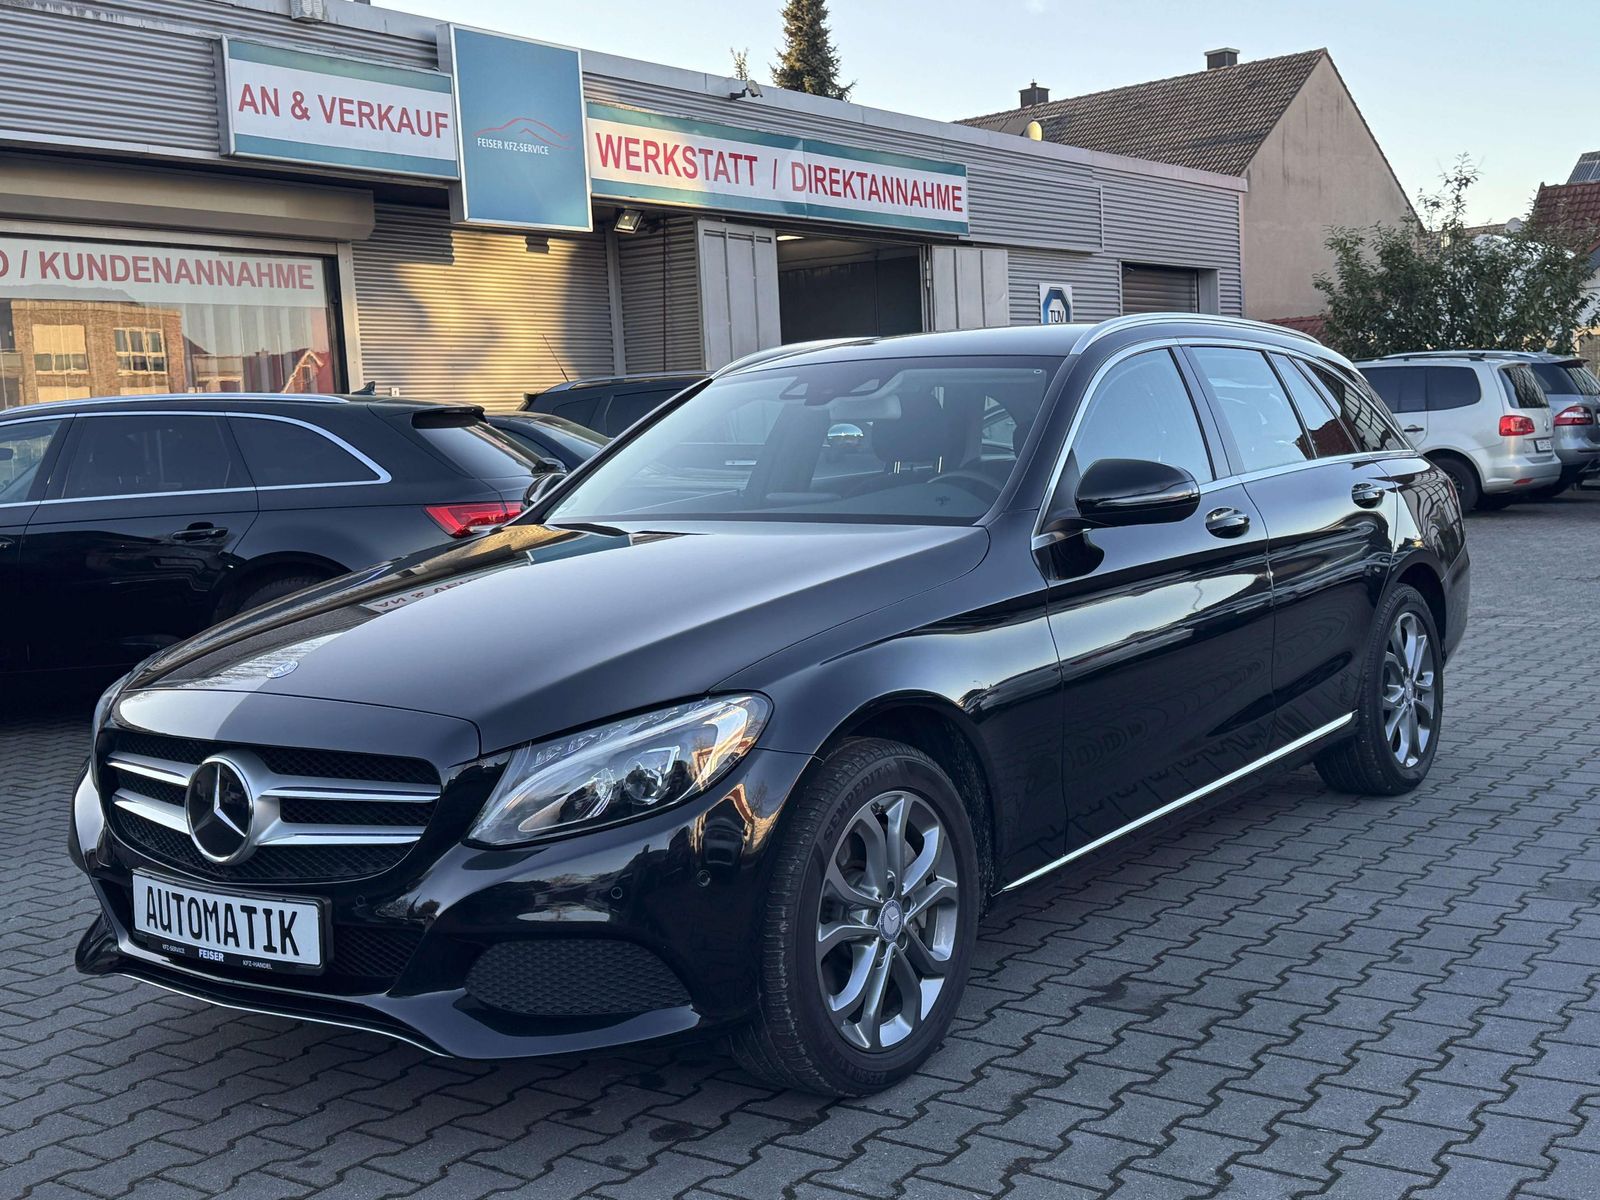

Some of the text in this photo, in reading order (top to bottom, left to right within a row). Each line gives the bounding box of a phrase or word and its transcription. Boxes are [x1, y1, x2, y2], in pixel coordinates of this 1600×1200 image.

[238, 83, 449, 139] AN & VERKAUF
[477, 137, 550, 156] FEISER KFZ-SERVICE
[595, 132, 963, 213] WERKSTATT / DIREKTANNAHME
[19, 249, 28, 279] /
[38, 250, 315, 290] KUNDENANNAHME
[146, 885, 300, 956] AUTOMATIK
[198, 948, 224, 962] FEISER
